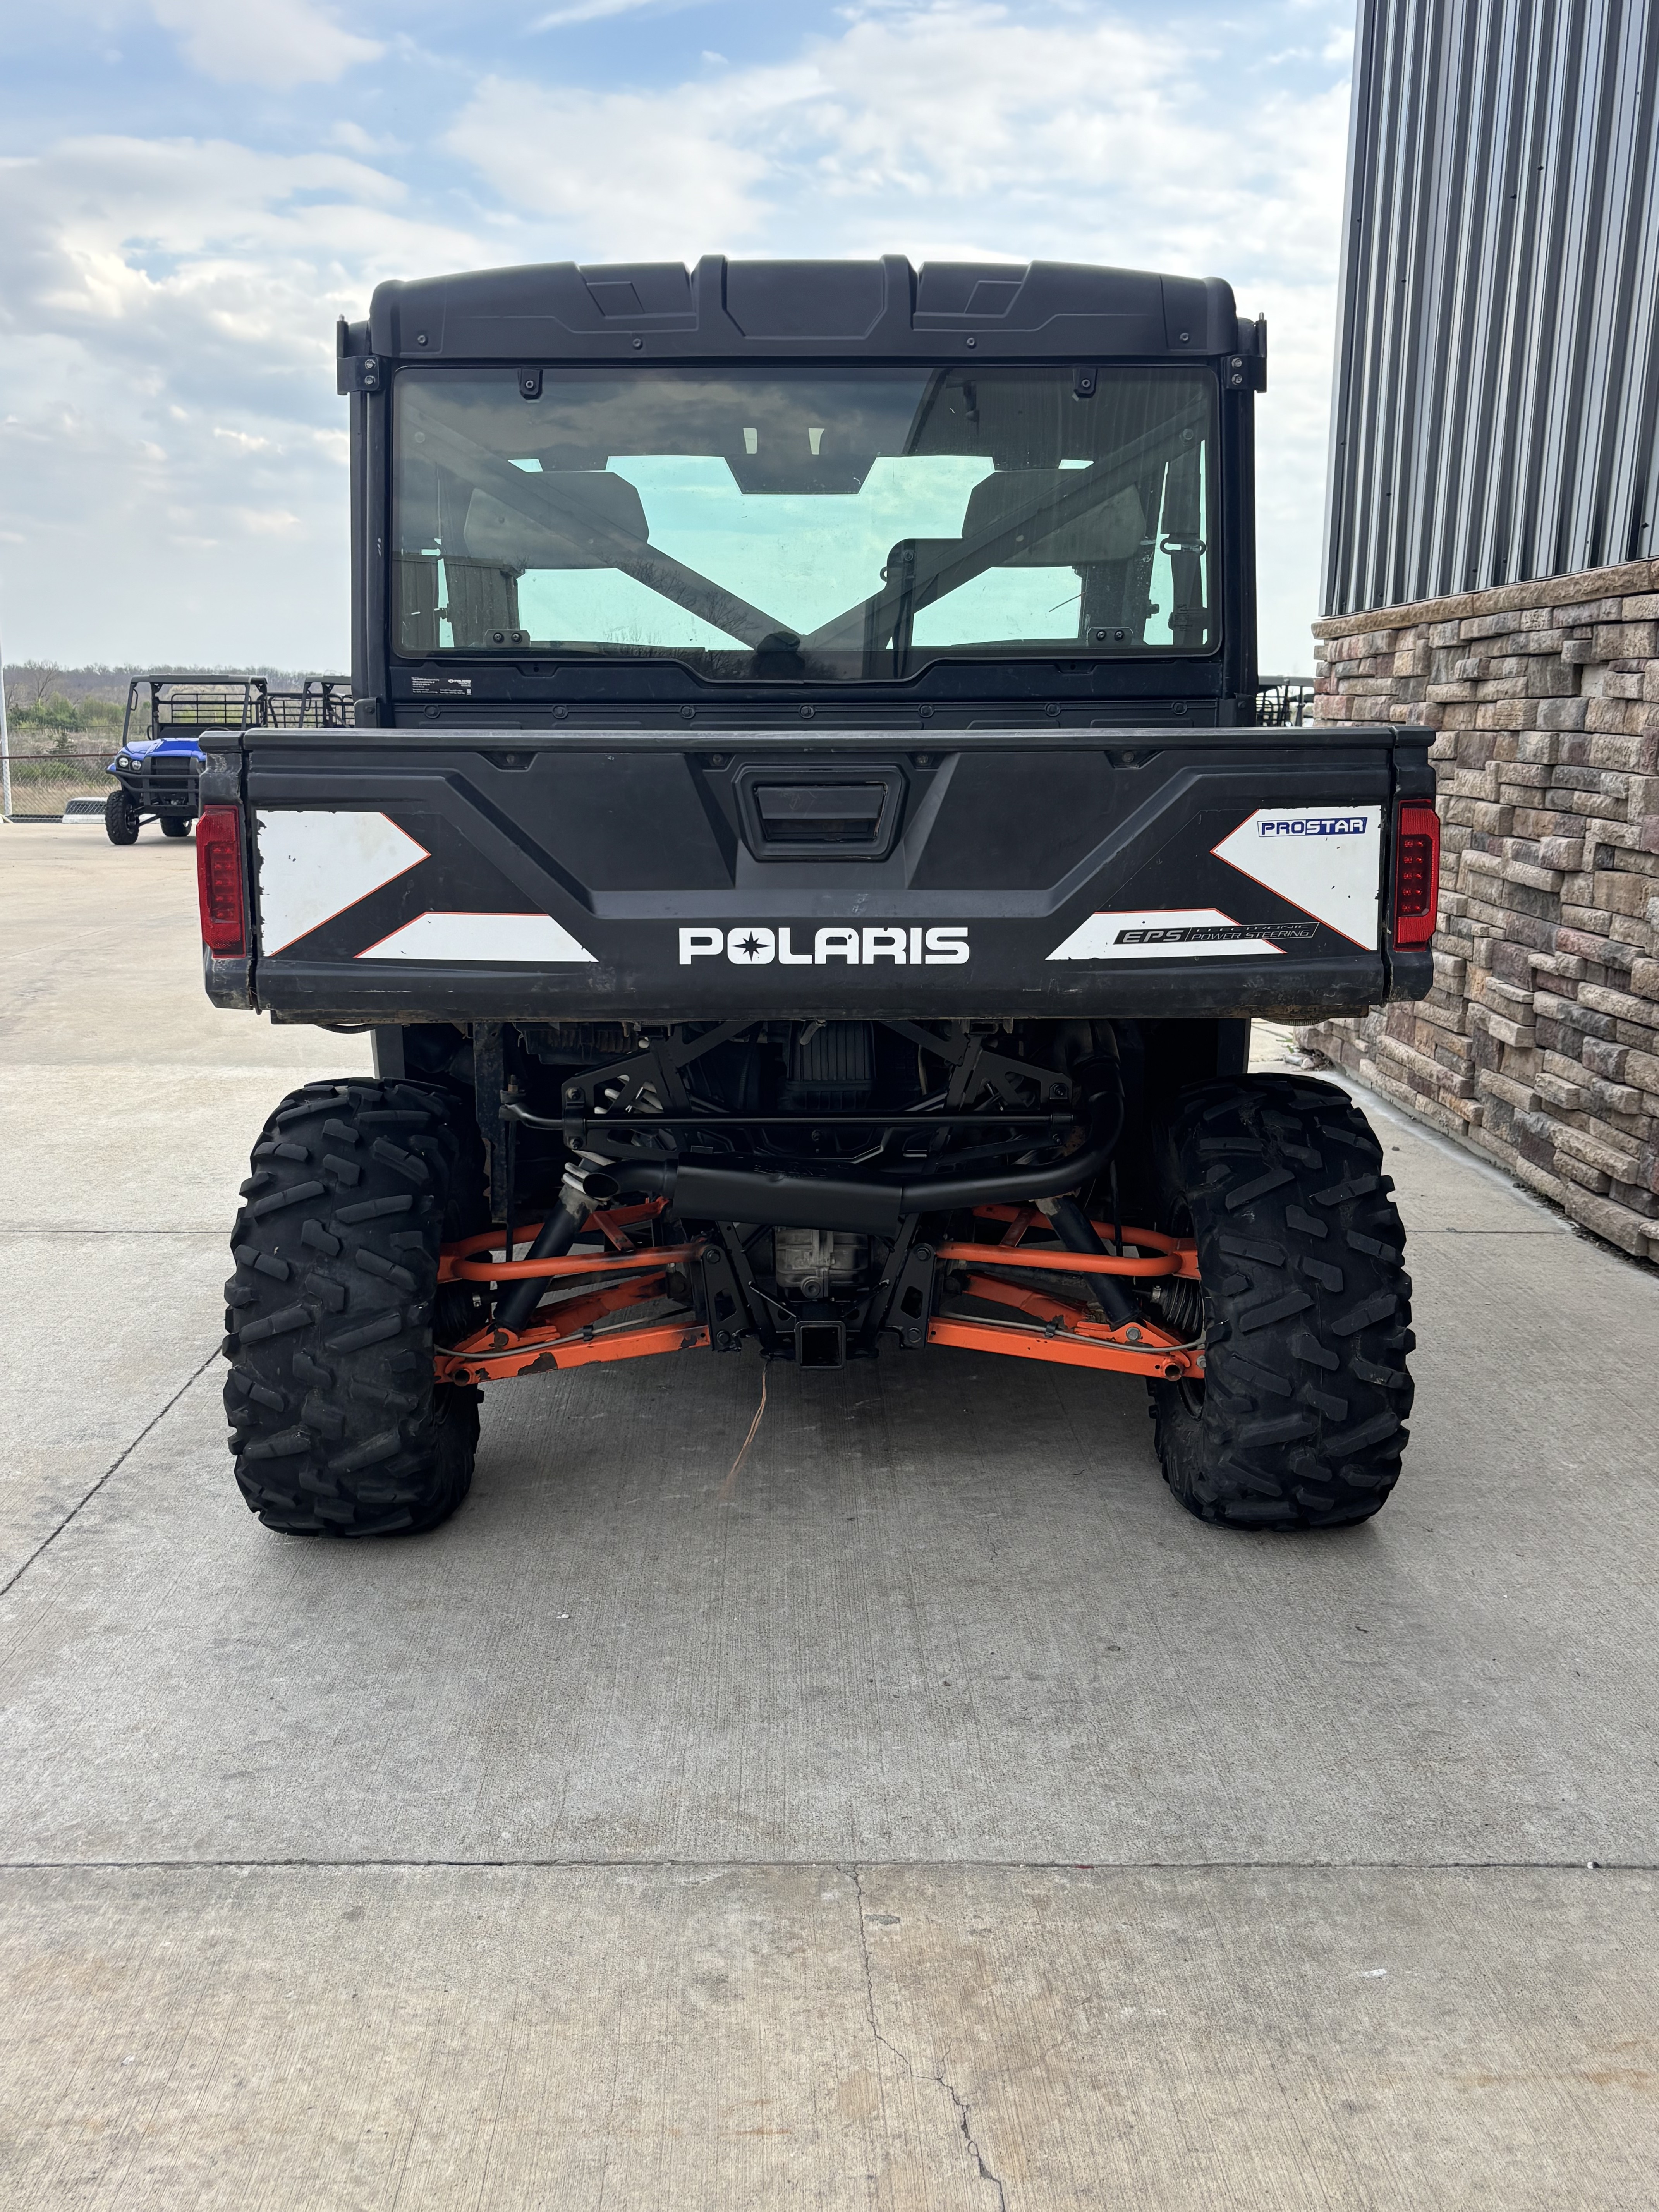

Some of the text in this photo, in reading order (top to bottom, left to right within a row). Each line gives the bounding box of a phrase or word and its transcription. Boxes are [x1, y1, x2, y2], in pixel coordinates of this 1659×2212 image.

[1261, 819, 1364, 835] PROSTAR
[1123, 930, 1184, 943] EPS
[1191, 930, 1310, 941] POWER STEERING
[679, 927, 970, 965] POLARIS
